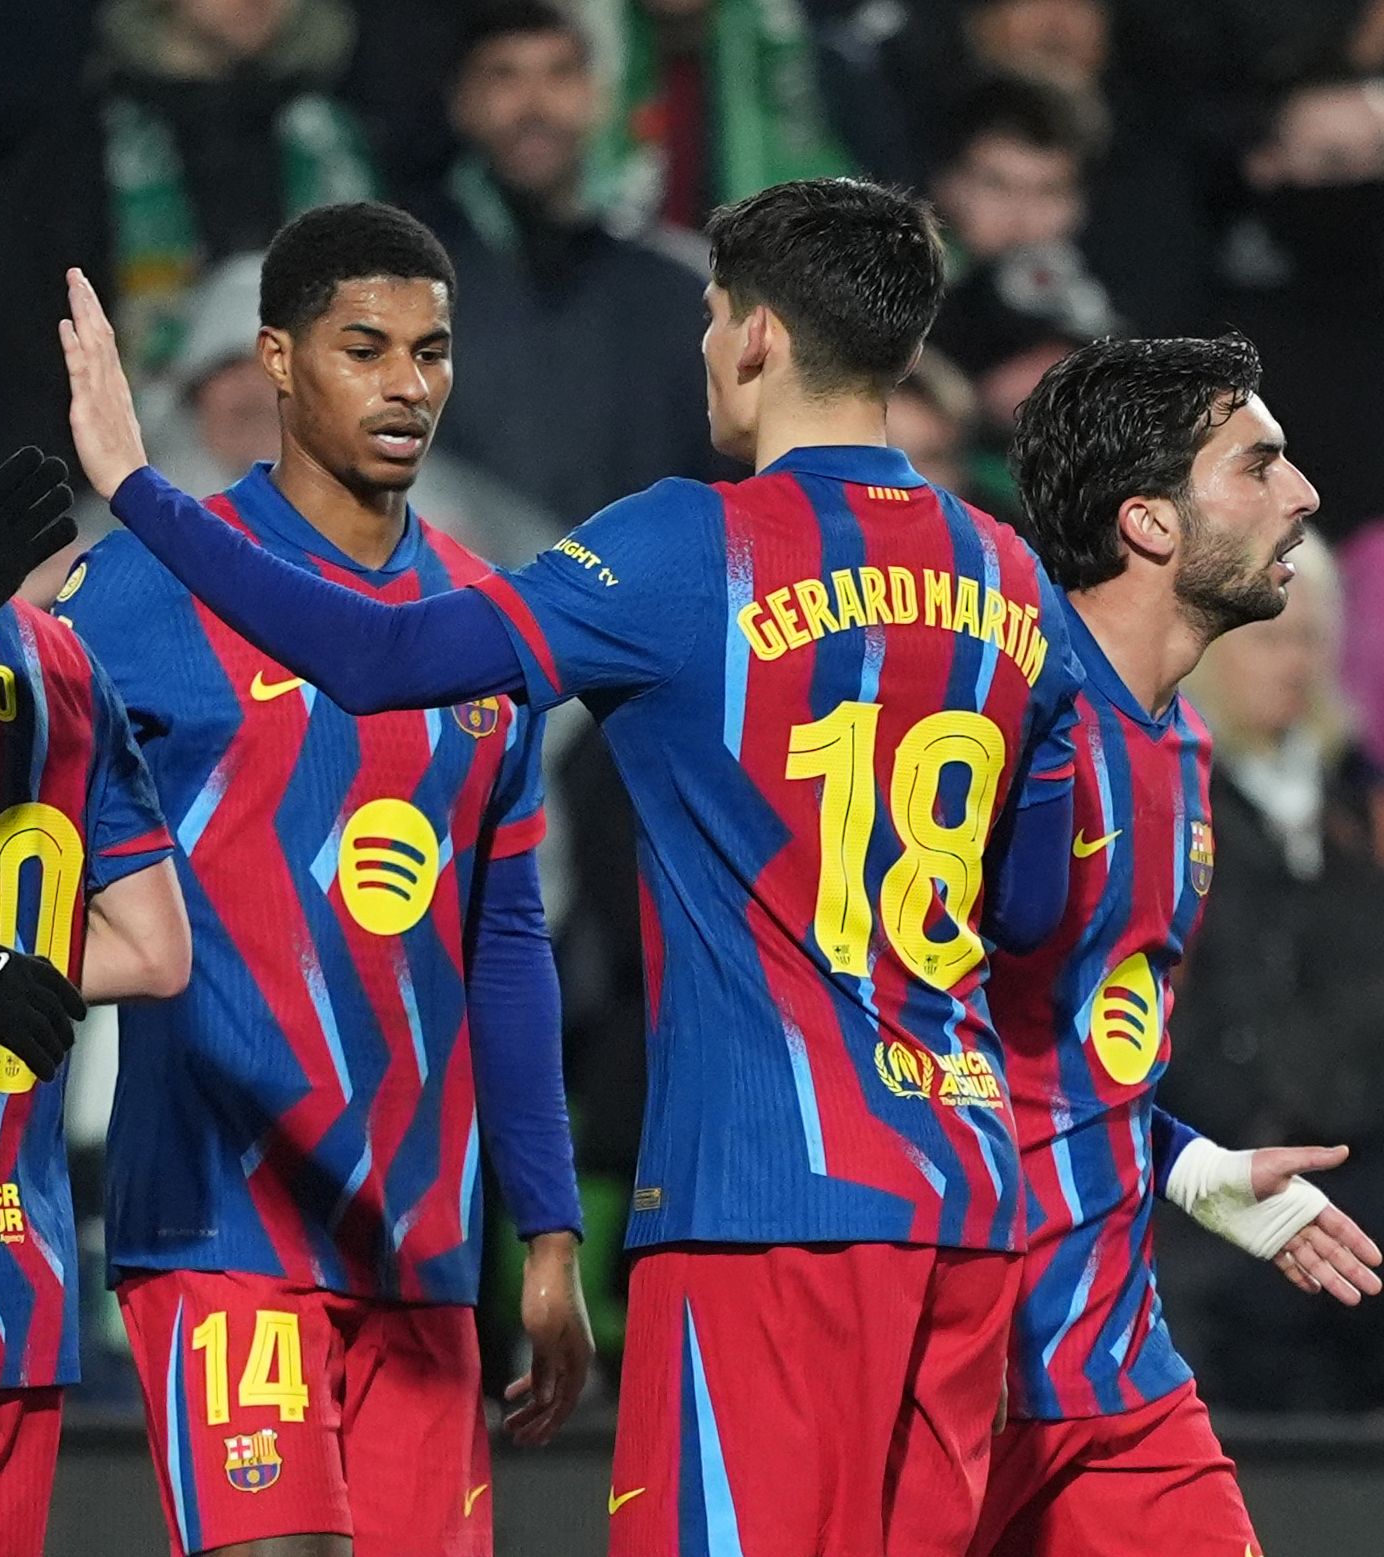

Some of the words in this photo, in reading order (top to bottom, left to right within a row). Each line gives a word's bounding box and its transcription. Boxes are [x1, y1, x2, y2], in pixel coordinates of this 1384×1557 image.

[552, 538, 601, 570] LIGHT
[598, 567, 619, 587] tv
[737, 566, 918, 661] GERARD
[923, 568, 1048, 688] MARTÍN
[785, 700, 1006, 991] 18
[192, 1310, 309, 1425] 14
